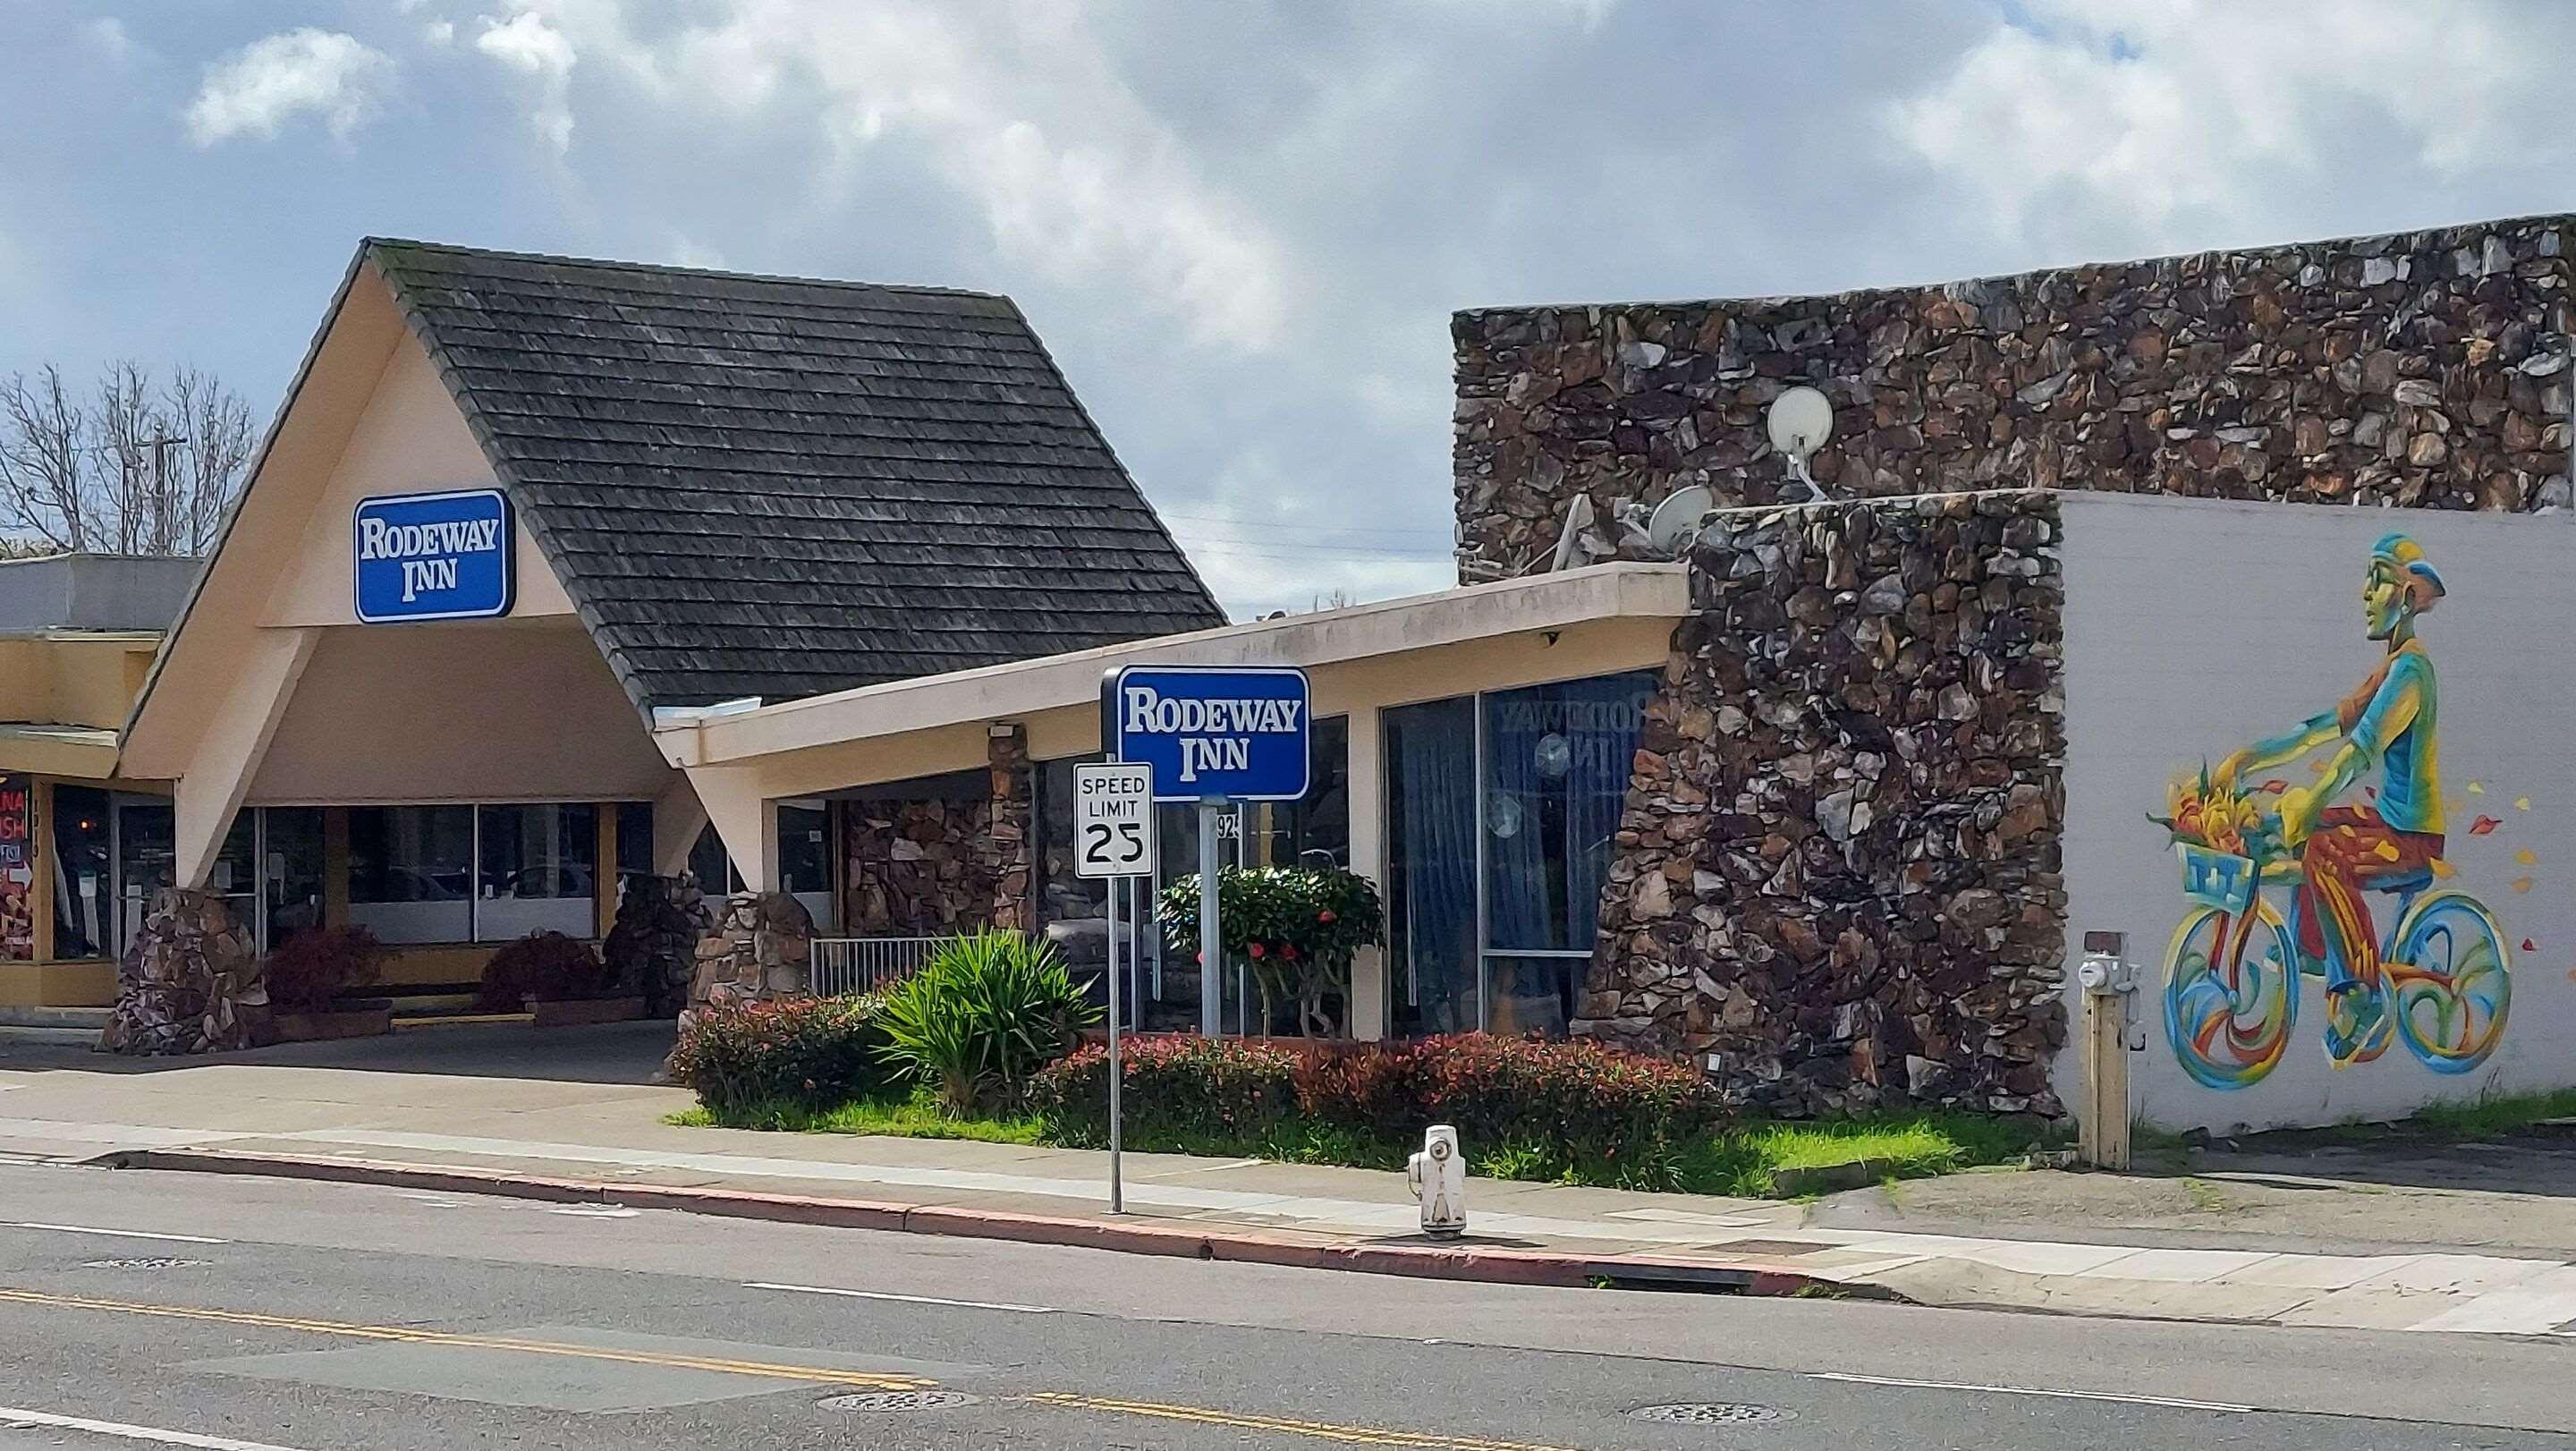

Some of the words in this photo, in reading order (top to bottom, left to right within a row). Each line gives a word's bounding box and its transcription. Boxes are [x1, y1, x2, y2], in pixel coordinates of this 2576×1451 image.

[360, 517, 500, 560] RODEWAY
[402, 557, 459, 603] INN
[1124, 686, 1302, 734] RODEWAY
[1178, 737, 1250, 783] INN
[1081, 776, 1146, 795] SPEED
[1089, 800, 1139, 818] LIMIT
[1085, 822, 1144, 863] 25
